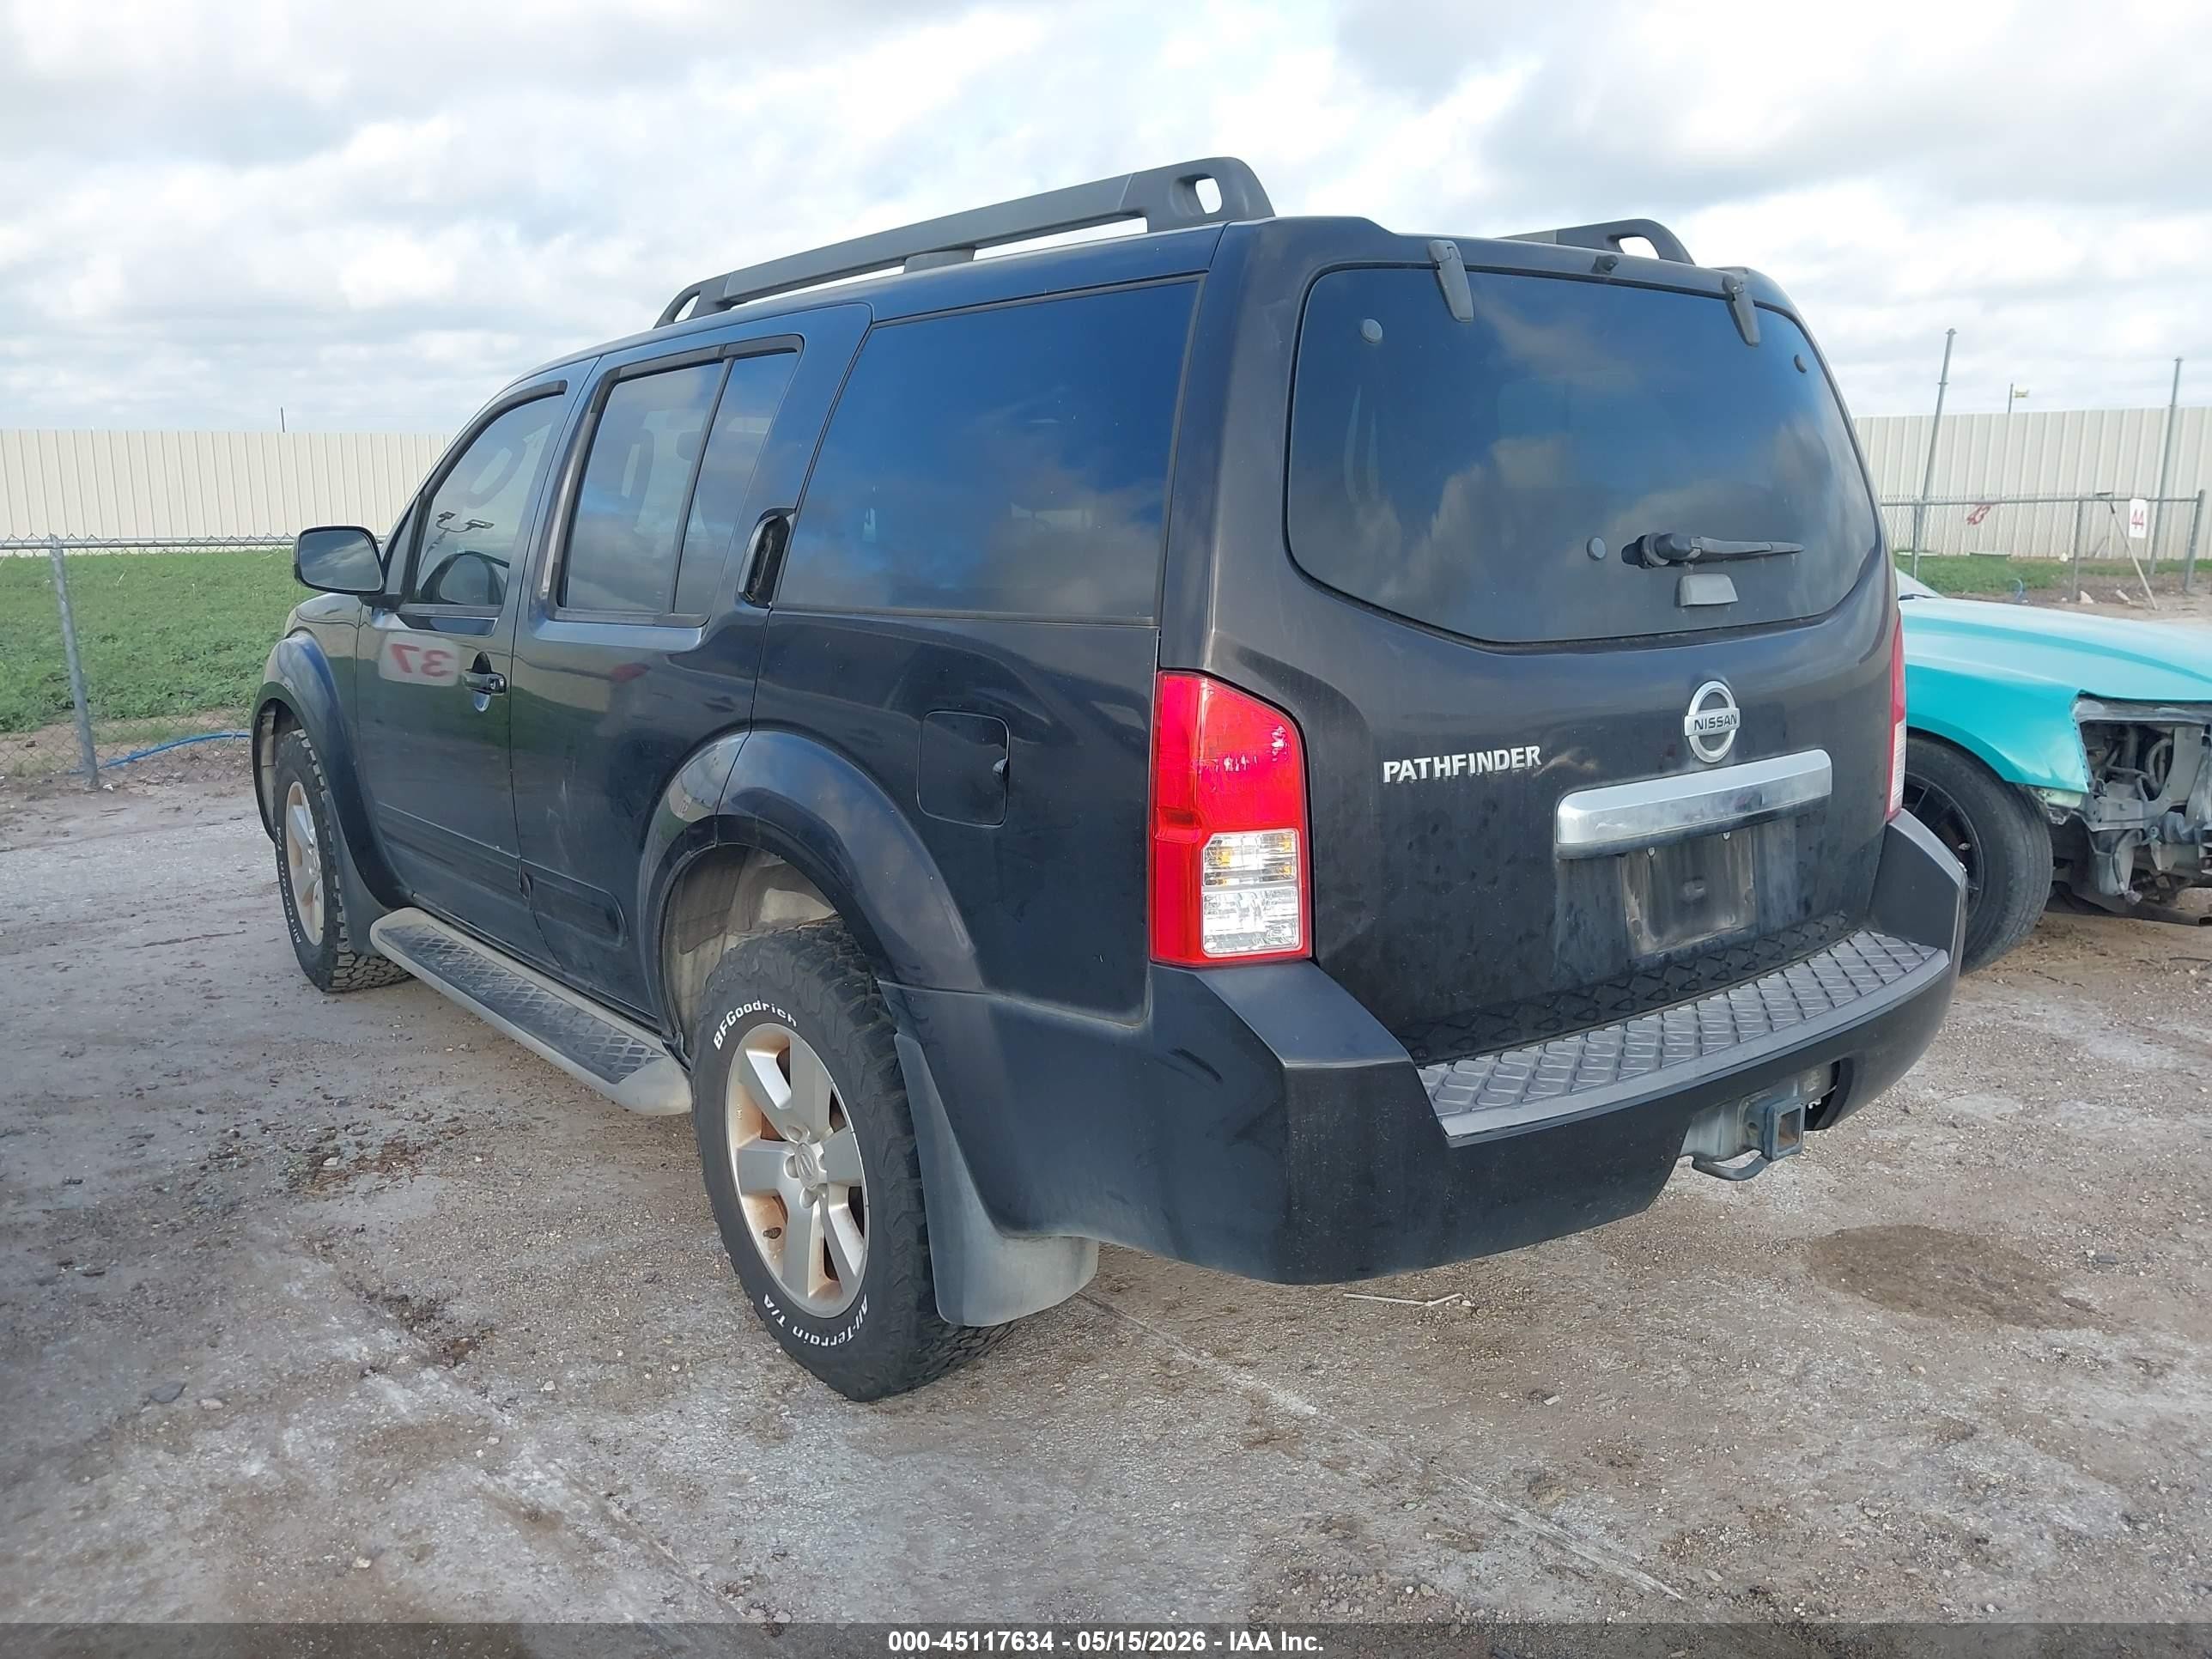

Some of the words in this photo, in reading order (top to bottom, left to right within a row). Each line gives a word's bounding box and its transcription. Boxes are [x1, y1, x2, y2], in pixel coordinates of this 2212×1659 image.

[2130, 508, 2144, 531] 44
[1692, 713, 1738, 732] NISSAN
[1382, 744, 1542, 783] PATHFINDER
[713, 1000, 799, 1050] BFGoodrich
[762, 1292, 786, 1328] T/A
[793, 1292, 868, 1347] All-Terrain
